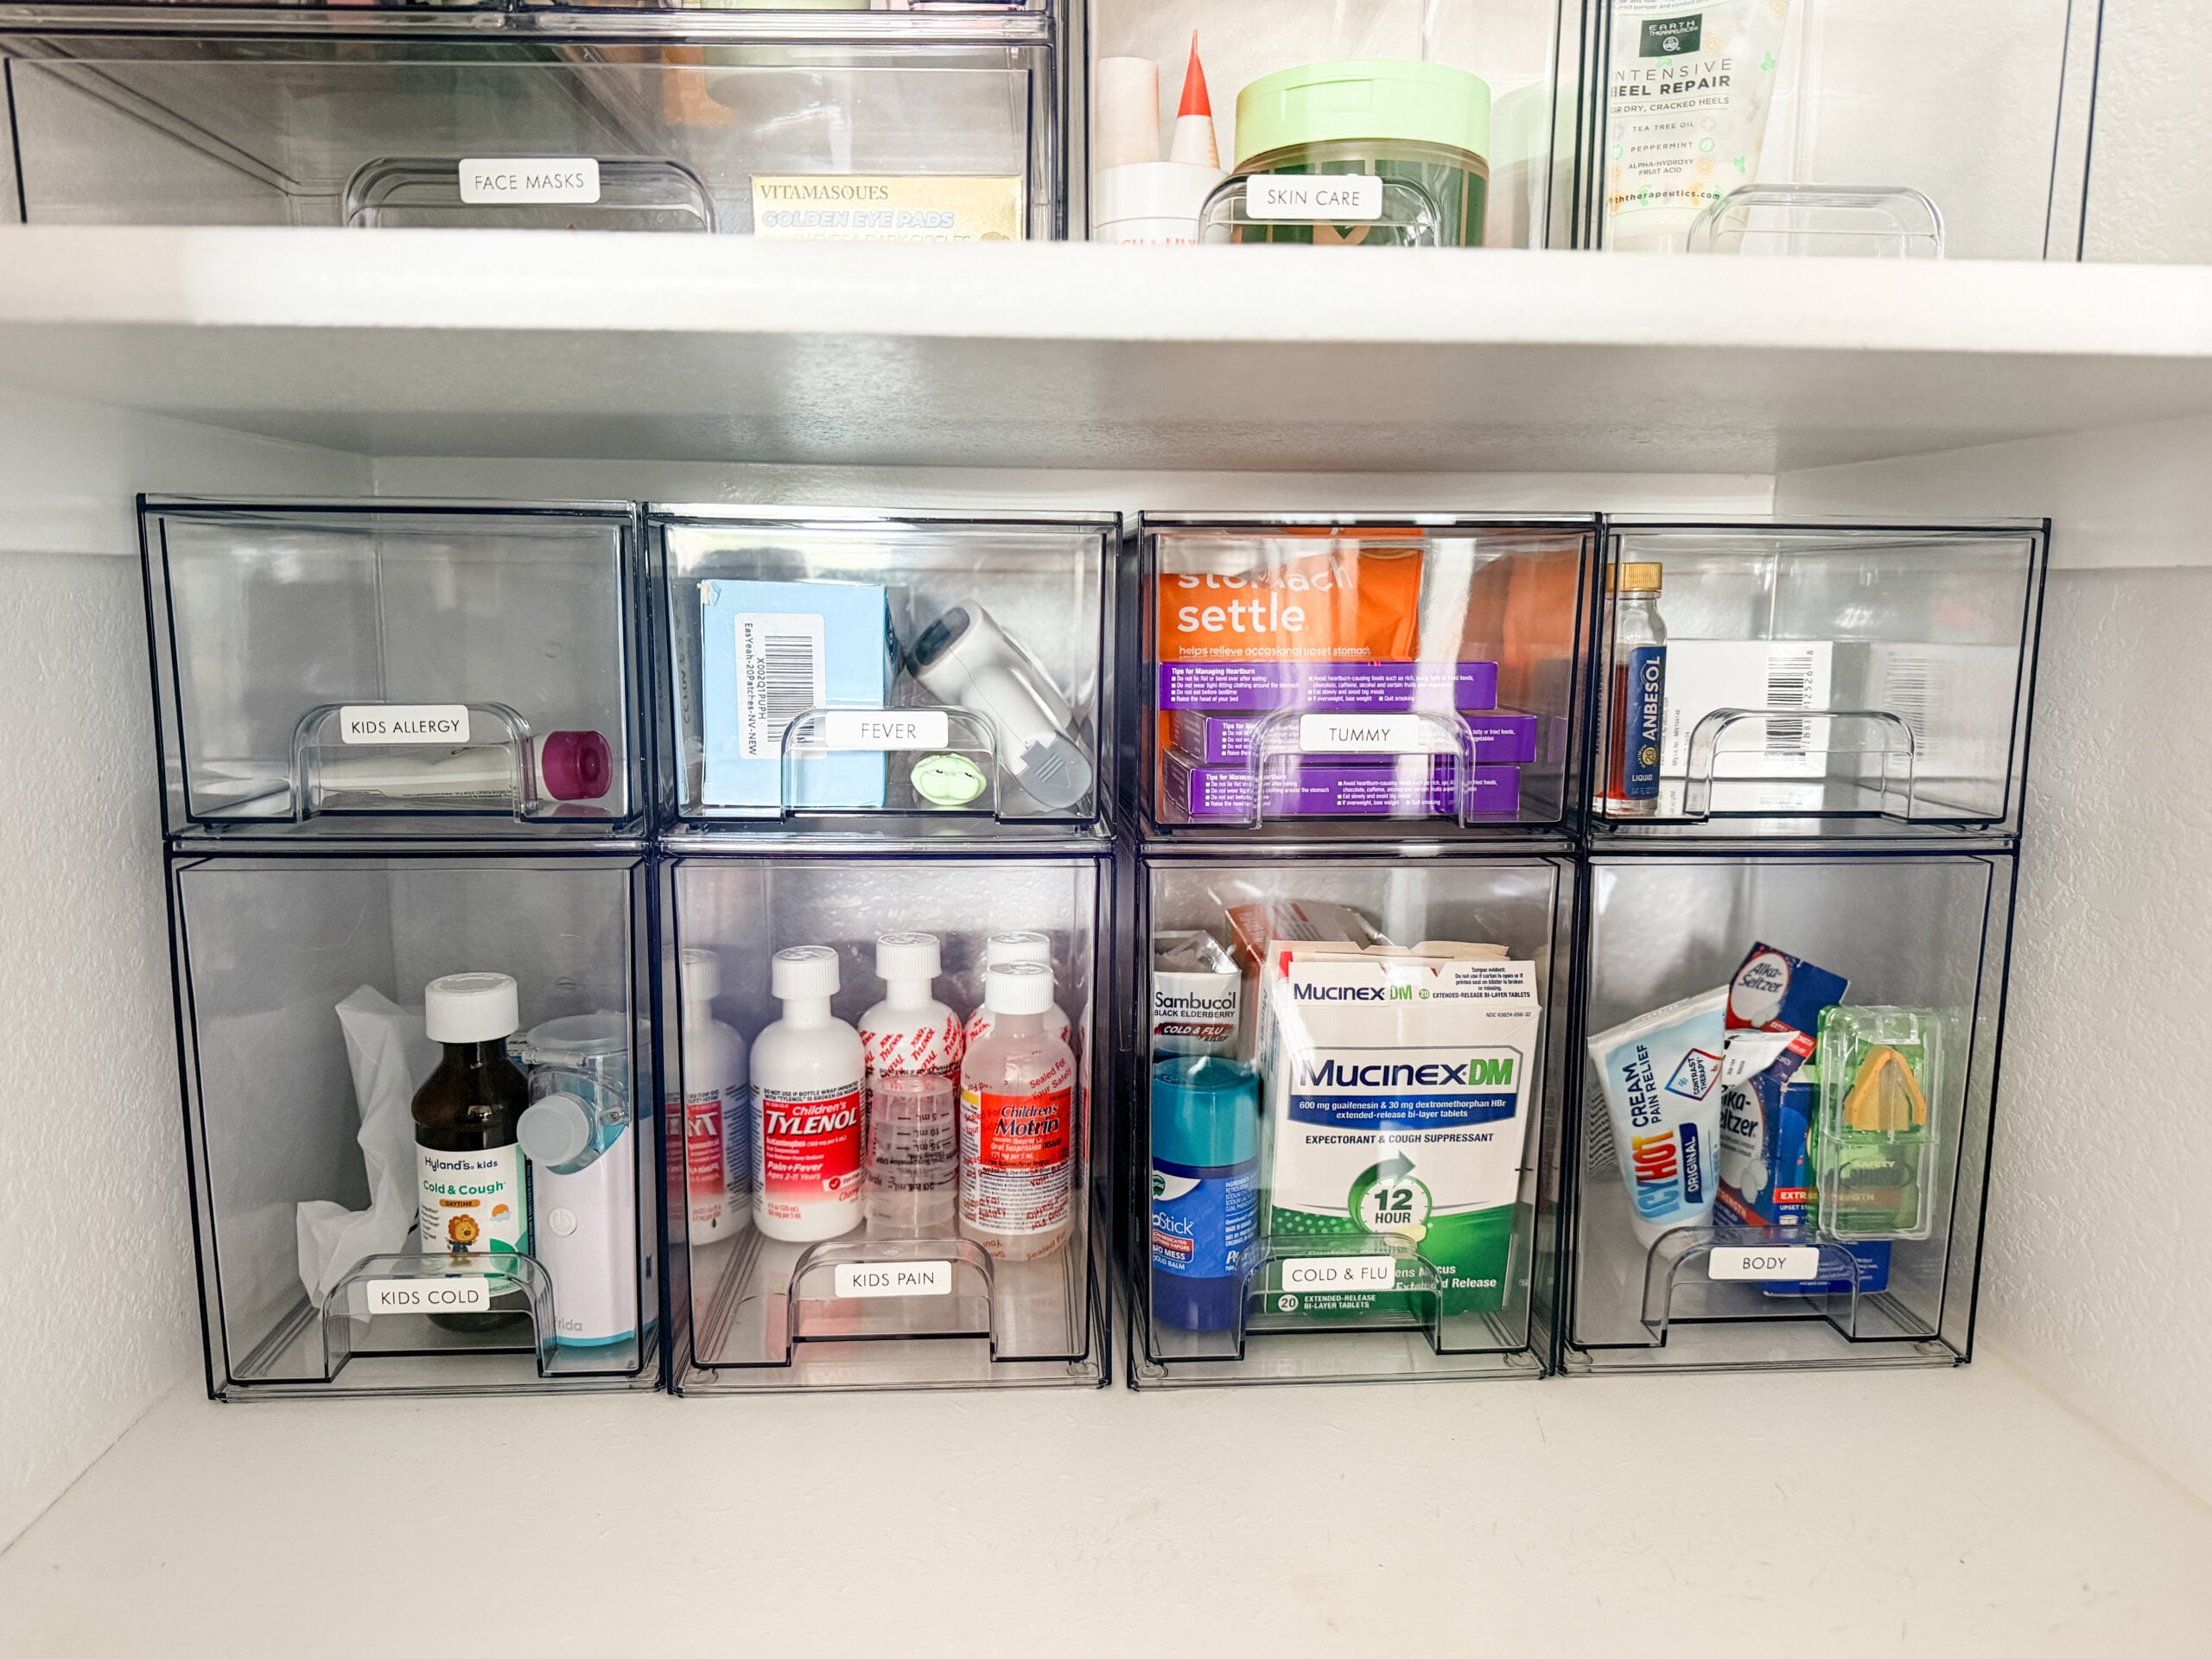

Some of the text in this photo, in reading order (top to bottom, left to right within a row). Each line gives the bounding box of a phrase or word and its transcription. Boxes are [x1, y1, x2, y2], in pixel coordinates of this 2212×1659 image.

[1649, 20, 1695, 30] EARTH
[1616, 58, 1732, 81] NTENSIVE
[1660, 74, 1731, 95] REPAIR
[1624, 105, 1647, 113] DRY,
[1649, 99, 1696, 111] CRACKED
[1699, 97, 1730, 107] HEELS
[1630, 142, 1694, 153] PEPPERMINT
[1628, 158, 1694, 170] ALPHA-HYDROXY
[1638, 168, 1660, 176] FRUIT
[474, 172, 585, 190] FACE MASKS
[760, 185, 889, 201] VITAMASQUES
[1268, 188, 1361, 207] SKIN CARE
[761, 210, 955, 229] GOLDEN EYE PADS
[1177, 592, 1306, 632] settle
[1179, 645, 1208, 657] helps
[1210, 645, 1243, 657] relieve
[1244, 645, 1302, 657] occasional
[1304, 645, 1332, 657] upset
[756, 657, 767, 720] X002Q1PUPH
[1643, 655, 1662, 741] ANBESOL
[351, 719, 460, 734] KIDS ALLERGY
[861, 722, 917, 740] FEVER
[1329, 727, 1391, 742] TUMMY
[1644, 748, 1656, 763] 20
[1747, 962, 1783, 978] Alka-
[1738, 974, 1783, 993] Seltzer
[1294, 983, 1385, 1001] Mucinex
[1389, 984, 1413, 1001] DM
[1154, 991, 1236, 1010] Sambucol
[1154, 1009, 1236, 1019] BLACK ELDERBERRY
[1163, 1025, 1224, 1035] COLD & FLU
[1029, 1058, 1066, 1089] Sealed For
[1300, 1058, 1514, 1087] Mucinex DM
[1687, 1057, 1701, 1095] CONTRAST
[1697, 1058, 1707, 1091] THERAPY
[1636, 1044, 1662, 1124] PAIN RELIEF
[1621, 1062, 1651, 1128] CREAM
[1722, 1084, 1751, 1111] lka-
[792, 1101, 847, 1116] Children's
[1001, 1104, 1058, 1118] Children's
[1299, 1101, 1315, 1109] 600
[1316, 1103, 1330, 1111] mg
[1332, 1101, 1379, 1111] guaifenesin
[1381, 1101, 1388, 1109] &
[1389, 1101, 1399, 1109] 30
[1400, 1102, 1414, 1110] mg
[1415, 1099, 1490, 1109] dextromethorphan
[766, 1107, 858, 1135] TYLENOL
[1336, 1109, 1468, 1120] extended-release bi-layer tablets
[995, 1116, 1059, 1136] Motrin
[1720, 1109, 1758, 1138] eltzer
[766, 1136, 806, 1149] Acetaminophen
[1306, 1133, 1494, 1144] EXPECTORANT & COUGH SUPPRESSANT
[1005, 1142, 1042, 1153] Suspension
[424, 1156, 499, 1173] Hyland's kids
[767, 1160, 823, 1173] Pain+Fever
[1687, 1136, 1701, 1193] ORIGINAL
[767, 1171, 784, 1180] Ages
[423, 1179, 505, 1196] Cold & Cough
[1374, 1188, 1413, 1211] 12
[1153, 1211, 1193, 1236] oStick
[1375, 1212, 1412, 1224] HOUR
[1164, 1249, 1185, 1261] MESS
[1167, 1261, 1185, 1270] BALM
[1742, 1257, 1787, 1270] BODY
[853, 1271, 934, 1287] KIDS PAIN
[1292, 1267, 1388, 1282] COLD & FLU
[1452, 1278, 1497, 1288] Release
[380, 1289, 480, 1306] KIDS COLD
[1281, 1294, 1376, 1308] 20 EXTENDED-RELEASE
